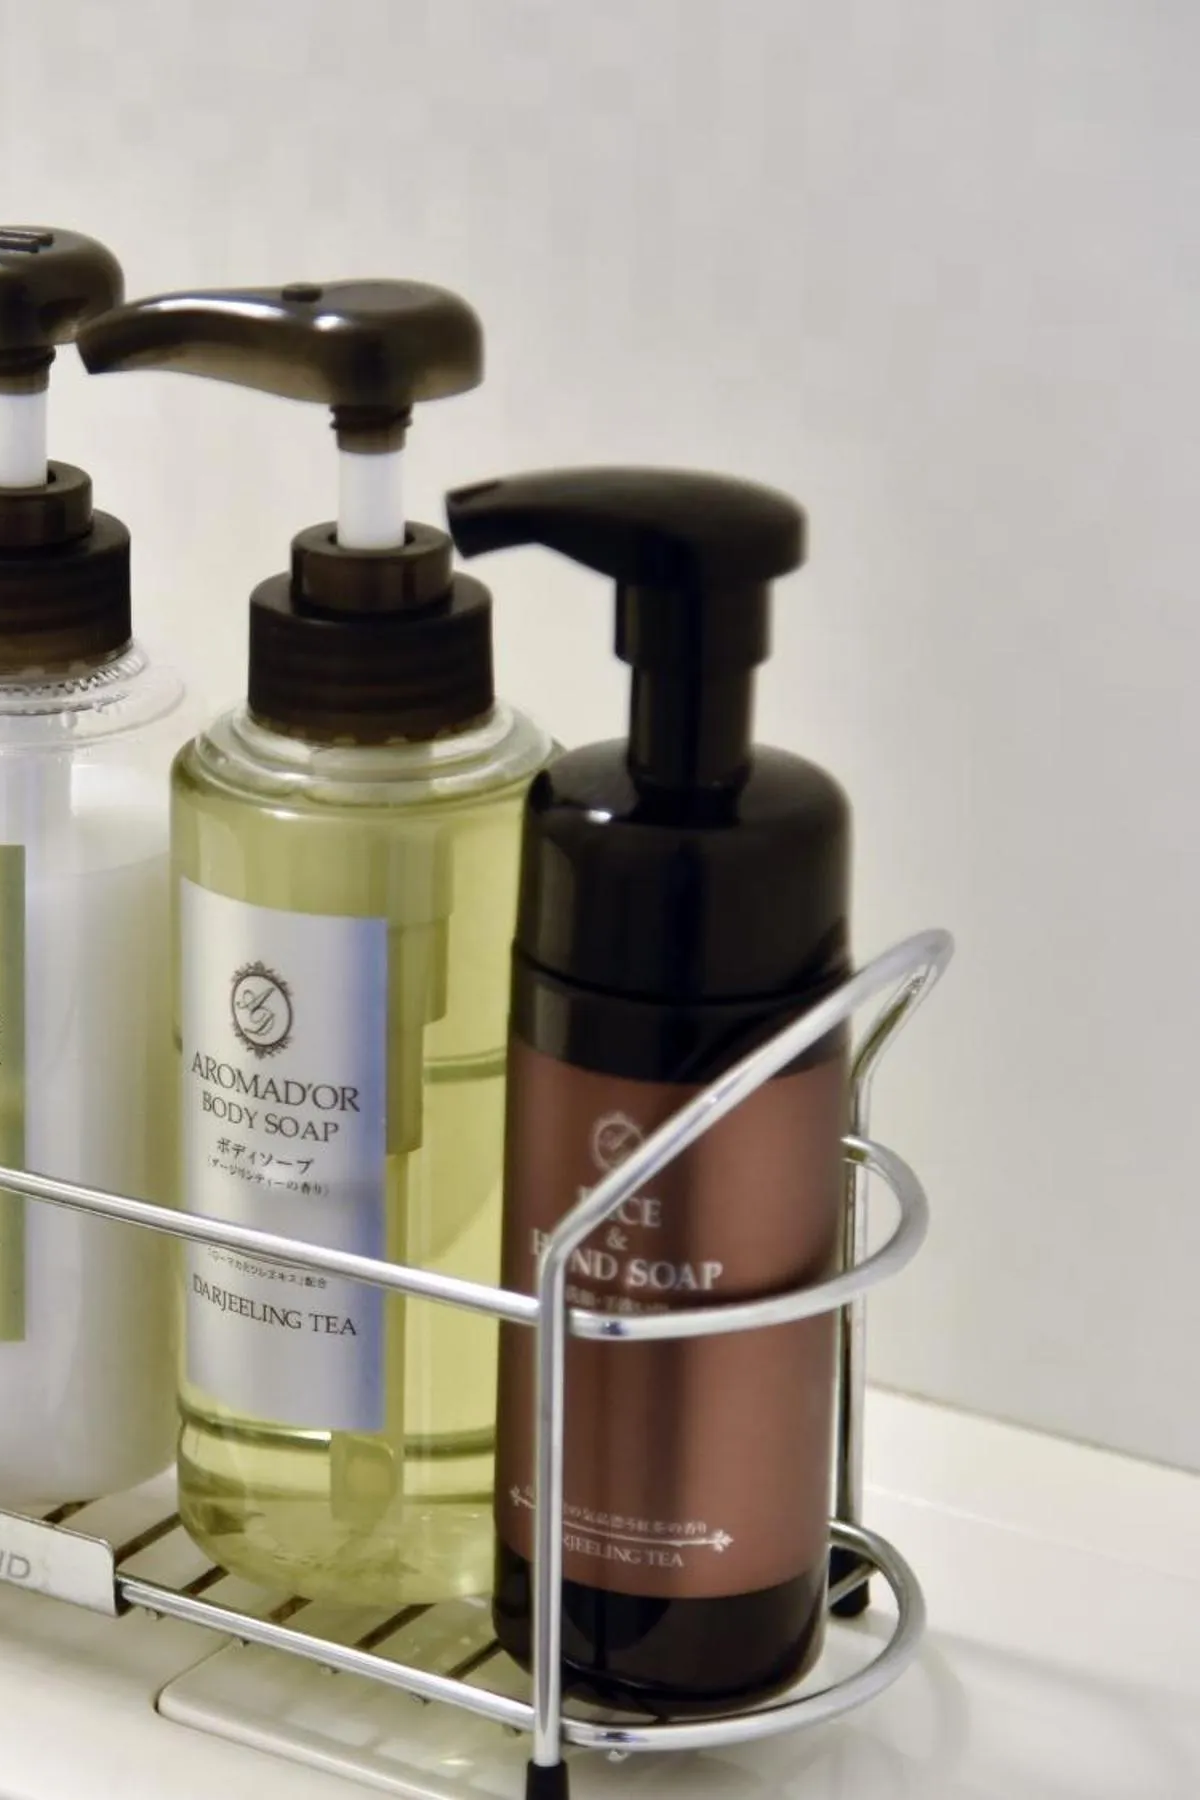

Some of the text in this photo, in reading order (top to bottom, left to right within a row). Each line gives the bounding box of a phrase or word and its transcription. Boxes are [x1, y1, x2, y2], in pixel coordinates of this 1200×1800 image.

[191, 1051, 361, 1113] AROMAD'OR
[202, 1090, 340, 1142] BODY SOAP
[216, 1136, 315, 1175] ボディソープ
[532, 1228, 724, 1290] HND SOAP
[606, 1227, 628, 1251] &
[193, 1273, 357, 1337] DARJEELING TEA
[648, 1549, 684, 1568] TEA
